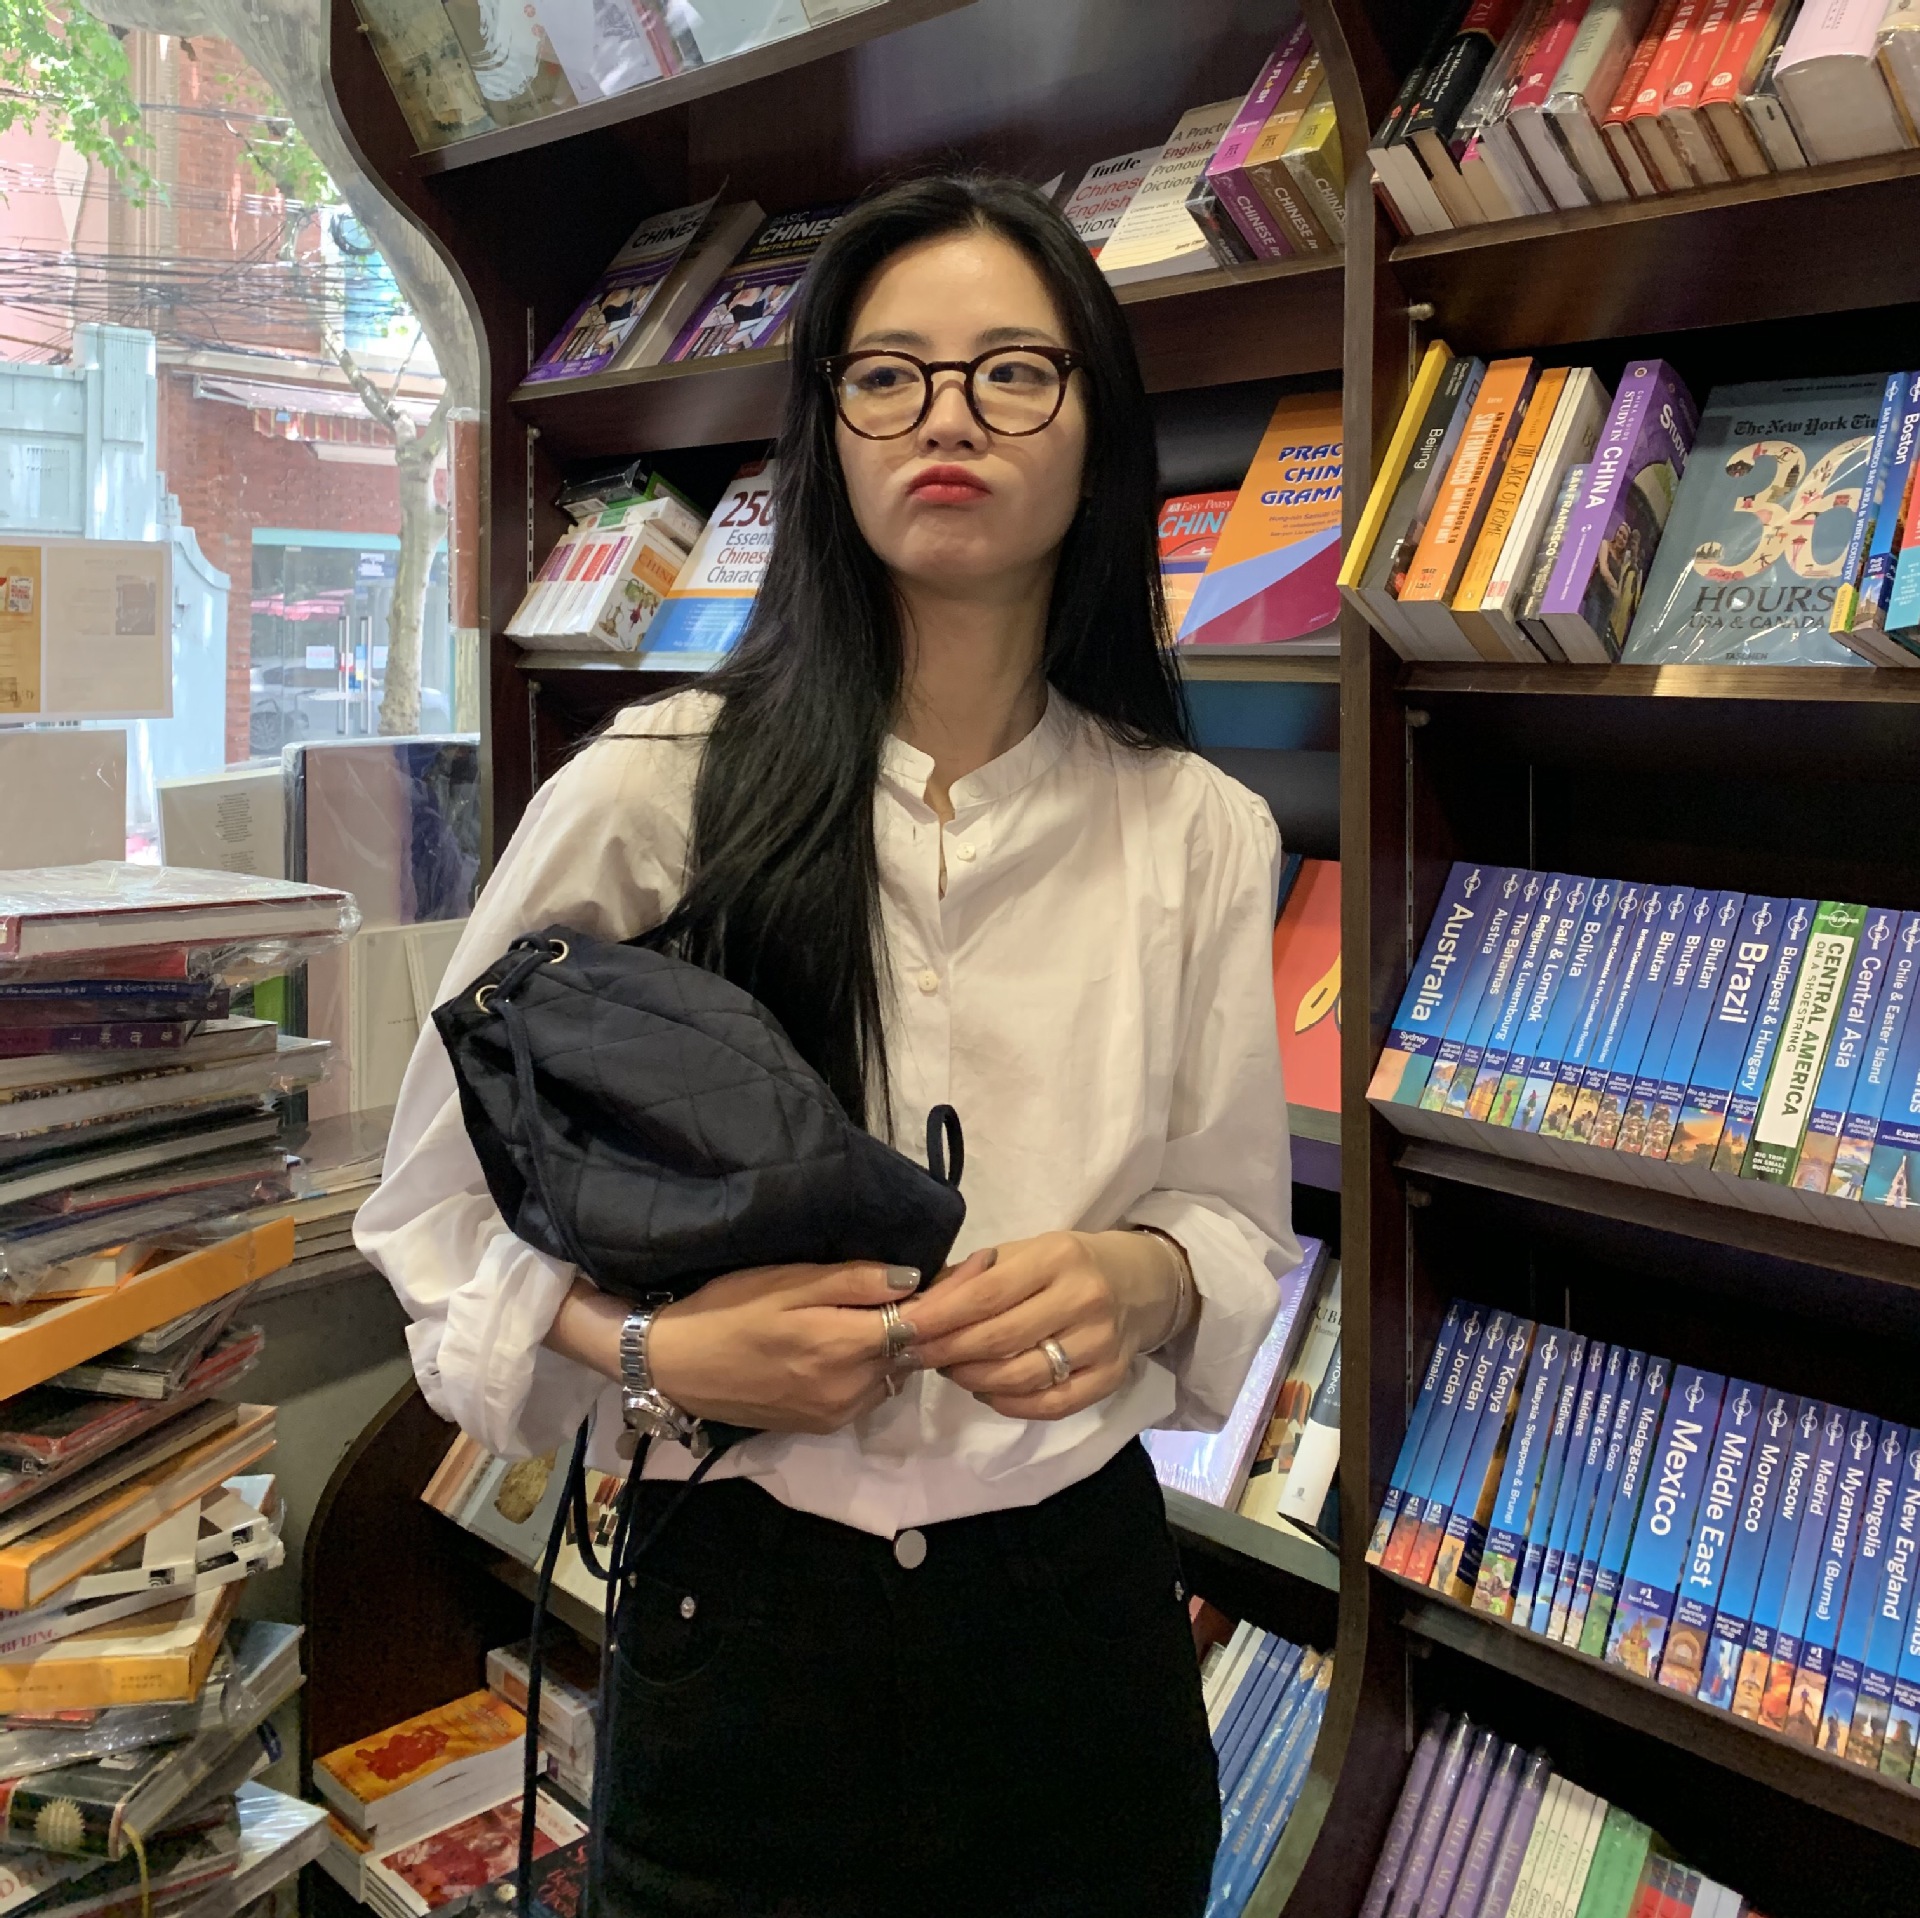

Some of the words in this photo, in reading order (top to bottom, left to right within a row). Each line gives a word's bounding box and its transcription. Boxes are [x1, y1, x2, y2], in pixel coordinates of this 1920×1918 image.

[1092, 158, 1141, 179] Tuttle
[1237, 195, 1277, 246] CHINESE
[1274, 187, 1313, 238] CHINESE
[1471, 413, 1496, 432] SAN
[1615, 390, 1635, 426] STUDY
[1734, 419, 1767, 436] The
[1768, 418, 1803, 435] New
[1804, 416, 1848, 436] York
[1413, 428, 1444, 470] Beijing
[1450, 434, 1489, 485] FRANCISCO
[1471, 424, 1500, 484] ARCHITECTURAL
[1516, 443, 1536, 458] THE
[1610, 430, 1622, 442] IN
[1895, 413, 1918, 465] Boston
[1505, 463, 1529, 488] SACK
[1568, 468, 1583, 491] SAN
[1585, 446, 1623, 509] CHINA
[1180, 501, 1201, 513] Easy
[1202, 498, 1234, 514] Peasy
[1456, 488, 1476, 530] GUIDEBOOK
[1486, 508, 1509, 537] ROME
[1499, 492, 1516, 507] OF
[1693, 435, 1876, 582] 36
[1546, 493, 1576, 556] FRANCISCO
[1853, 518, 1866, 540] WINE
[1842, 541, 1860, 581] COUNTRY
[1689, 615, 1723, 629] USA
[1729, 615, 1744, 629] &
[1749, 615, 1826, 629] CANADA
[1692, 586, 1838, 612] HOURS
[1482, 907, 1508, 954] Austria
[1510, 912, 1529, 935] The
[1526, 914, 1550, 960] Belgium
[1554, 918, 1575, 945] Bali
[1411, 902, 1474, 1022] Australia
[1489, 938, 1519, 995] Bahamas
[1522, 959, 1535, 970] &
[1551, 947, 1564, 960] &
[1568, 921, 1601, 977] Bolivia
[1647, 930, 1675, 981] Bhutan
[1673, 934, 1701, 986] Bhutan
[1697, 937, 1726, 989] Bhutan
[1812, 962, 1821, 970] A
[1816, 941, 1827, 957] ON
[1527, 965, 1559, 1022] Lombok
[1719, 942, 1769, 1024] Brazil
[1769, 945, 1798, 1011] Budapest
[1807, 942, 1845, 1025] CENTRAL
[1847, 956, 1881, 1024] Central
[1897, 958, 1912, 989] Chile
[1495, 971, 1531, 1041] Luxembourg
[1762, 1014, 1778, 1025] &
[1786, 974, 1817, 1053] SHOESTRING
[1891, 992, 1904, 1005] &
[1400, 1031, 1429, 1046] Sydney
[1879, 1004, 1901, 1044] Easter
[1741, 1028, 1773, 1091] Hungary
[1835, 1027, 1863, 1069] Asia
[1867, 1047, 1890, 1085] Island
[1781, 1030, 1819, 1116] AMERICA
[1424, 1342, 1448, 1391] Jamaica
[1441, 1348, 1470, 1406] Jordan
[1464, 1354, 1493, 1411] Jordan
[1489, 1364, 1516, 1413] Kenya
[1554, 1384, 1575, 1436] Maldives
[1575, 1388, 1594, 1437] Maldives
[1593, 1426, 1602, 1437] &
[1597, 1393, 1612, 1425] Malta
[1616, 1398, 1631, 1431] Malta
[1516, 1420, 1537, 1477] Singapore
[1587, 1438, 1602, 1466] Gozo
[1606, 1443, 1621, 1472] Gozo
[1614, 1432, 1623, 1440] &
[1623, 1407, 1654, 1500] Madagascar
[1514, 1477, 1523, 1487] &
[1650, 1419, 1704, 1536] Mexico
[1706, 1431, 1747, 1520] Middle
[1745, 1443, 1781, 1533] Morocco
[1782, 1451, 1811, 1521] Moscow
[1810, 1458, 1835, 1517] Madrid
[1503, 1488, 1521, 1525] Brunei
[1831, 1466, 1864, 1559] Myanmar
[1862, 1477, 1894, 1559] Mongolia
[1898, 1487, 1920, 1534] New
[1690, 1525, 1725, 1589] East
[1882, 1535, 1916, 1622] England
[1640, 1587, 1652, 1599] #1
[1815, 1560, 1842, 1621] (Burma)
[1811, 1646, 1822, 1659] #1
